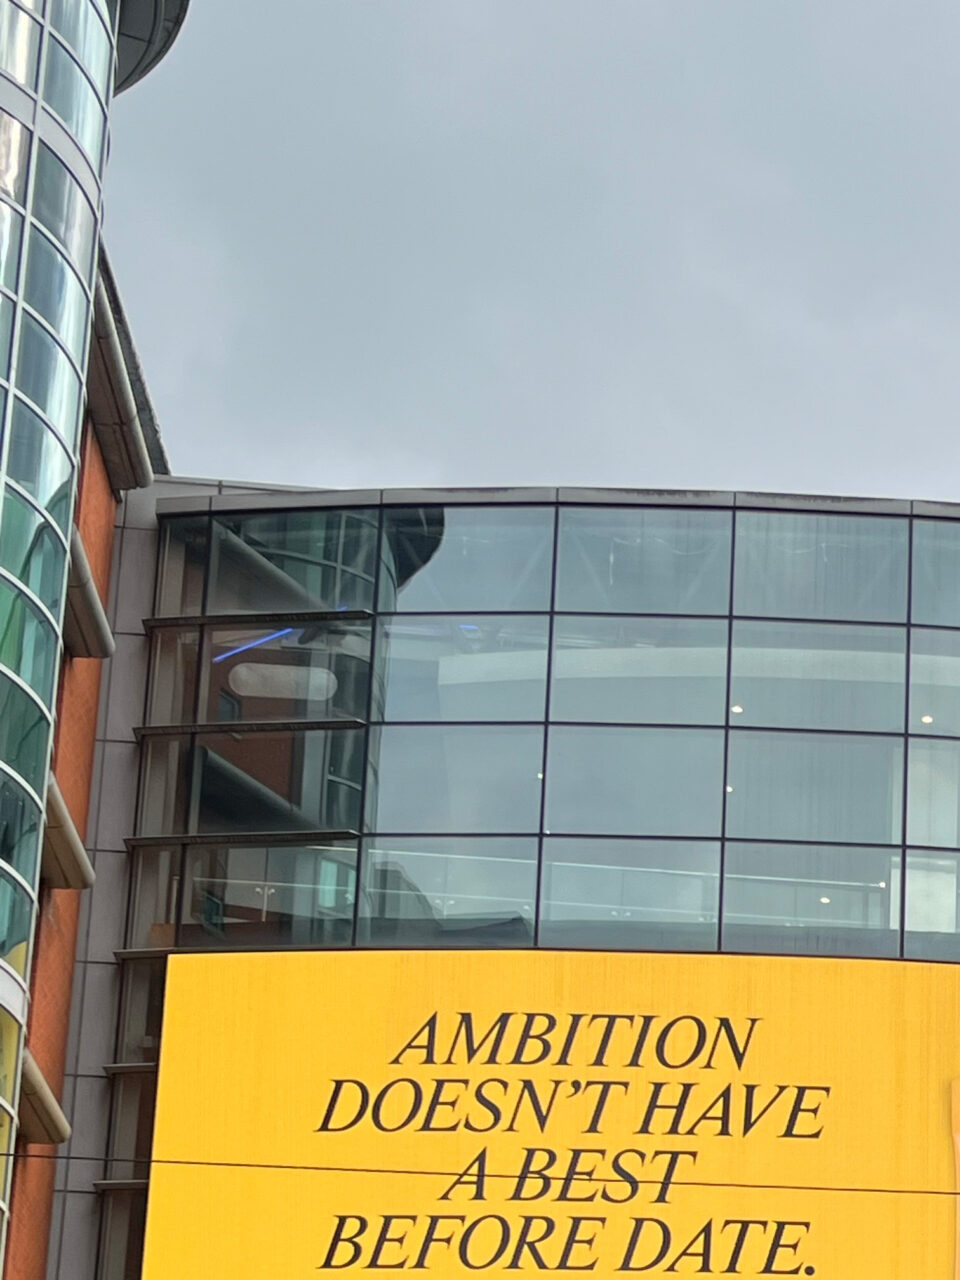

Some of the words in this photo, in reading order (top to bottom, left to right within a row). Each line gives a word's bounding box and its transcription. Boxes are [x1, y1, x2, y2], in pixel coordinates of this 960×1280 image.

[389, 1012, 762, 1070] AMBITION
[316, 1078, 631, 1134] DOESN'T
[634, 1083, 831, 1139] HAVE
[440, 1148, 488, 1202] A
[510, 1148, 698, 1203] BEST
[318, 1214, 606, 1271] BEFORE
[617, 1217, 817, 1277] DATE.
